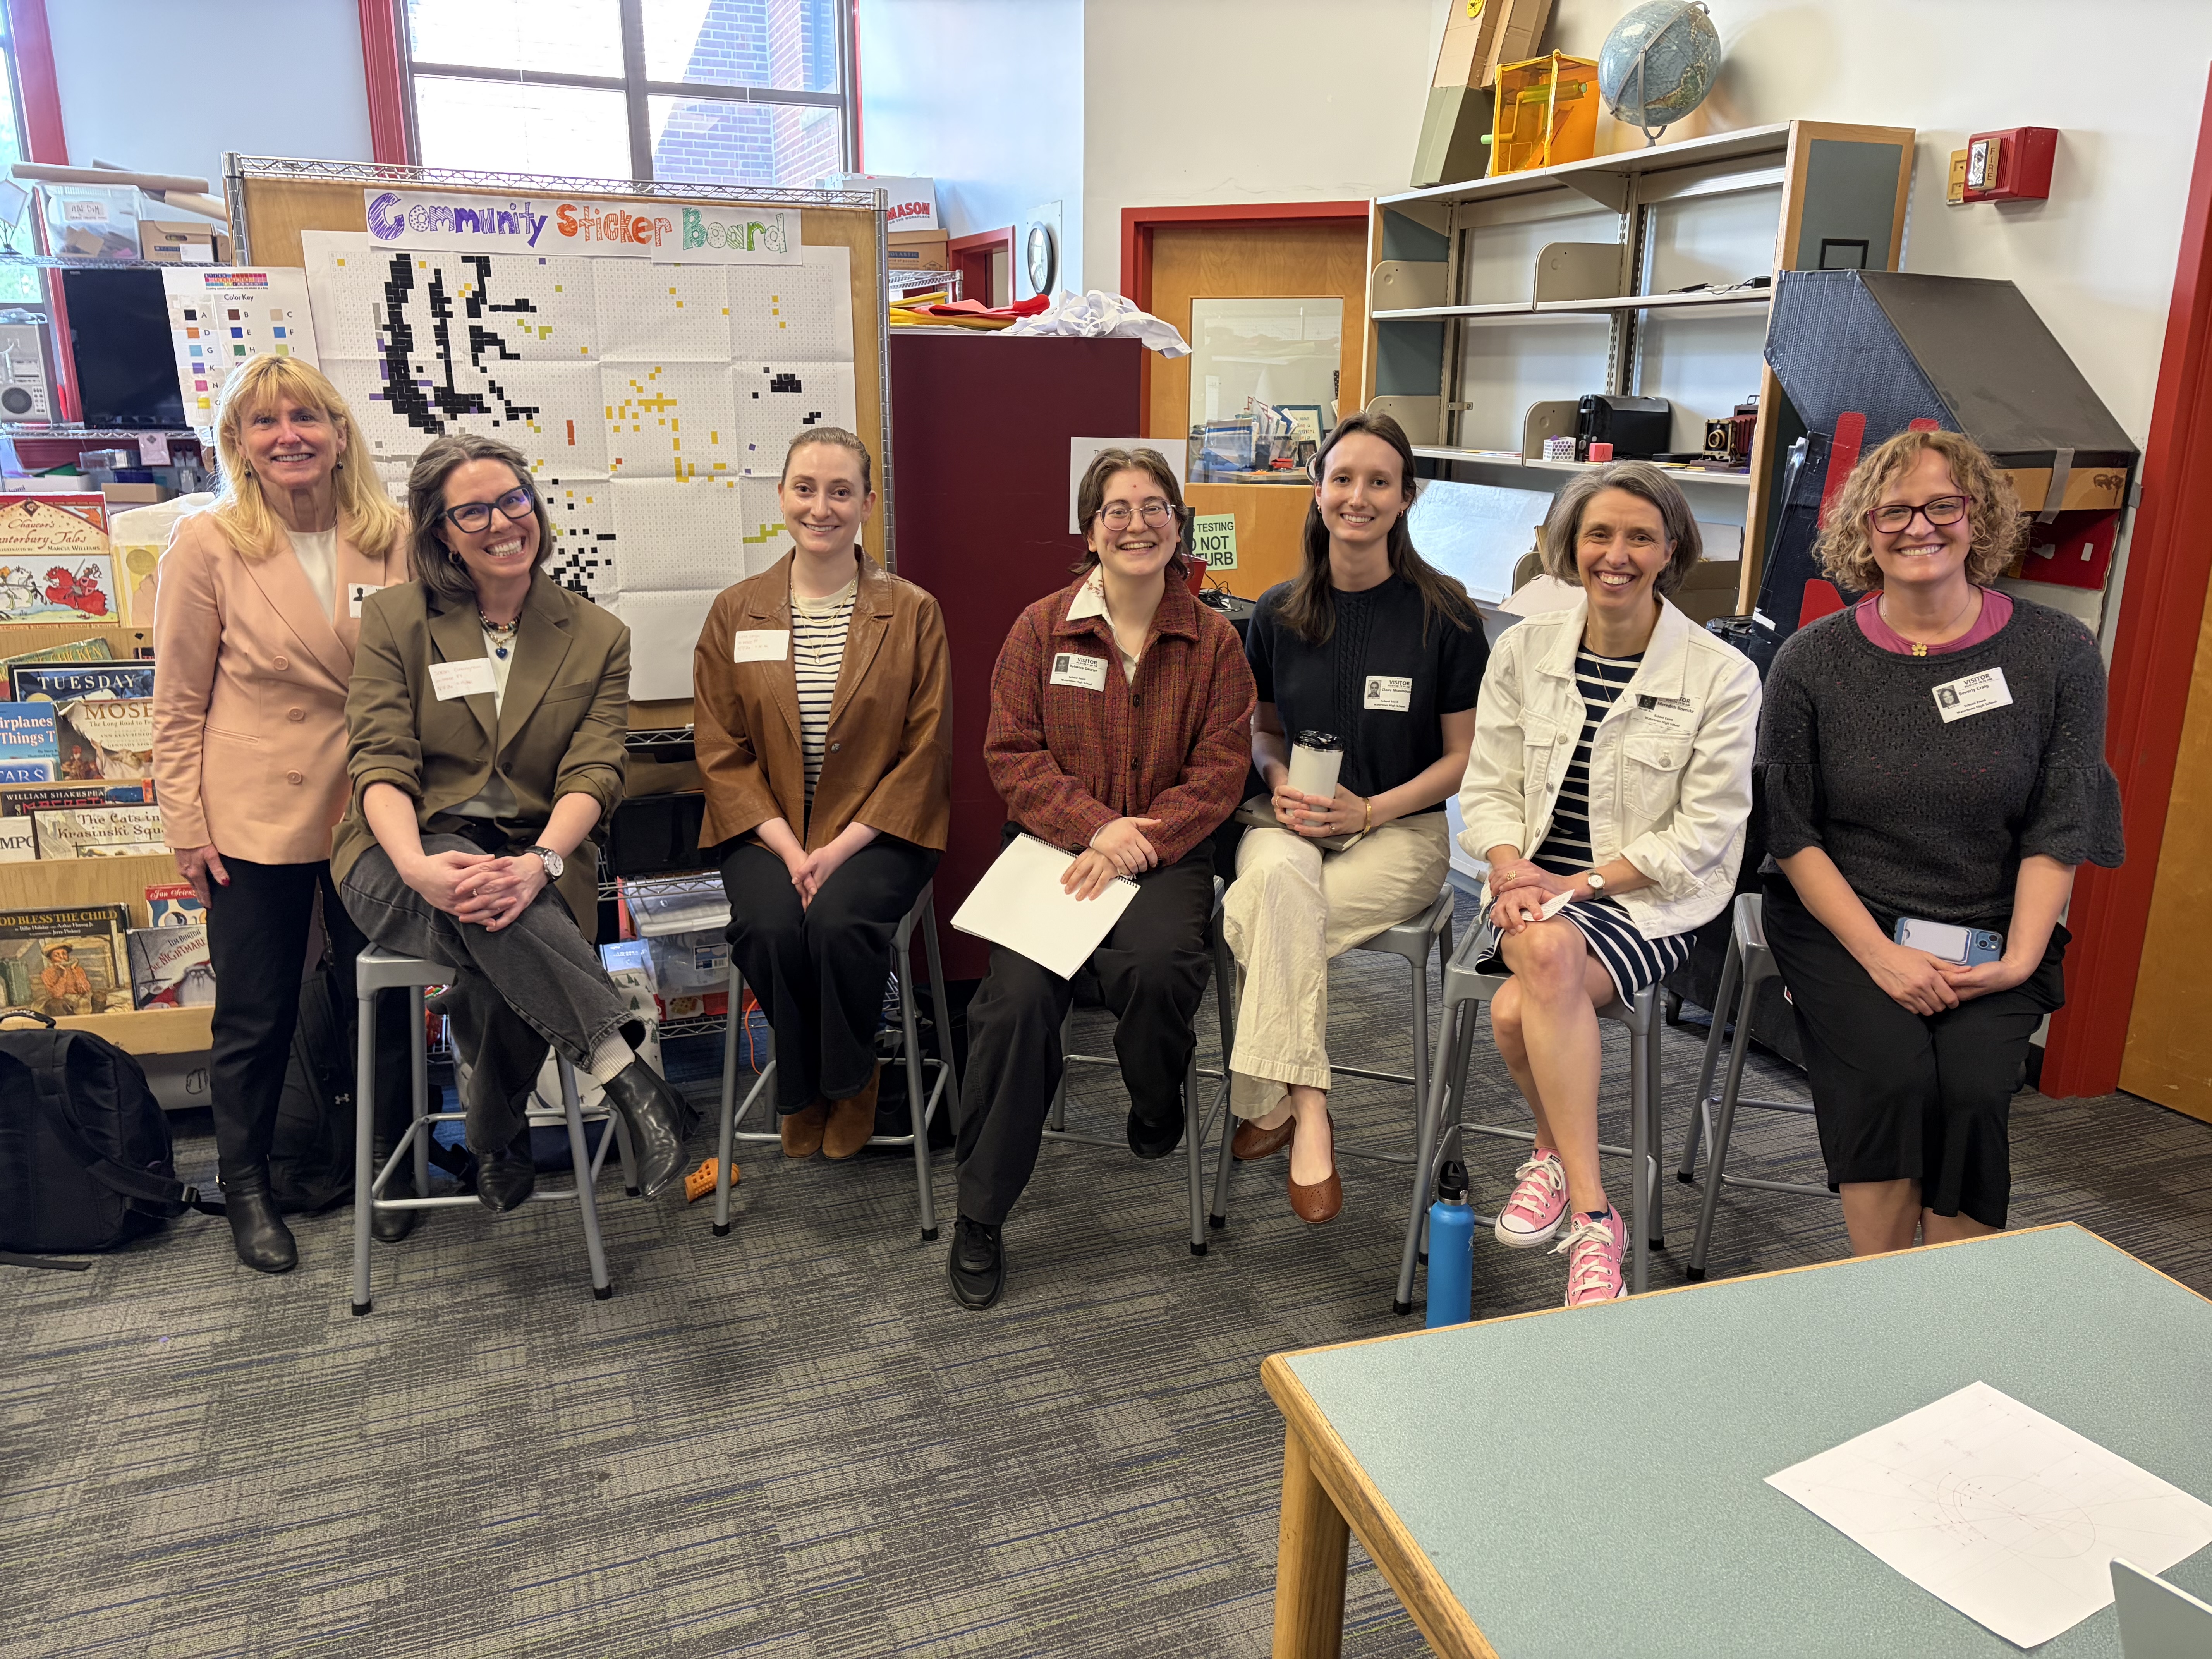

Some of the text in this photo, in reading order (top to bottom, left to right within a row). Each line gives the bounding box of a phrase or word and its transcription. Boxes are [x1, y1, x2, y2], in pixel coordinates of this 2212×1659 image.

[1987, 147, 1996, 180] FIRE
[886, 202, 930, 220] MASON
[367, 192, 787, 254] Community Sticker Board
[8, 519, 55, 529] Chaucer's
[1197, 522, 1233, 532] TESTING
[51, 529, 86, 544] Tales
[1201, 536, 1229, 551] NOT
[37, 674, 136, 690] TUESDAY
[1963, 673, 1990, 685] VISITOR
[1959, 688, 1975, 696] Beverly
[1657, 701, 1676, 709] Meredith
[0, 731, 44, 747] Things
[77, 814, 106, 825] The
[110, 812, 141, 823] Cats
[58, 825, 129, 839] Krasinski
[150, 889, 168, 900] Jon
[18, 914, 53, 925] BLESS
[54, 913, 79, 922] THE
[80, 910, 118, 921] CHILD
